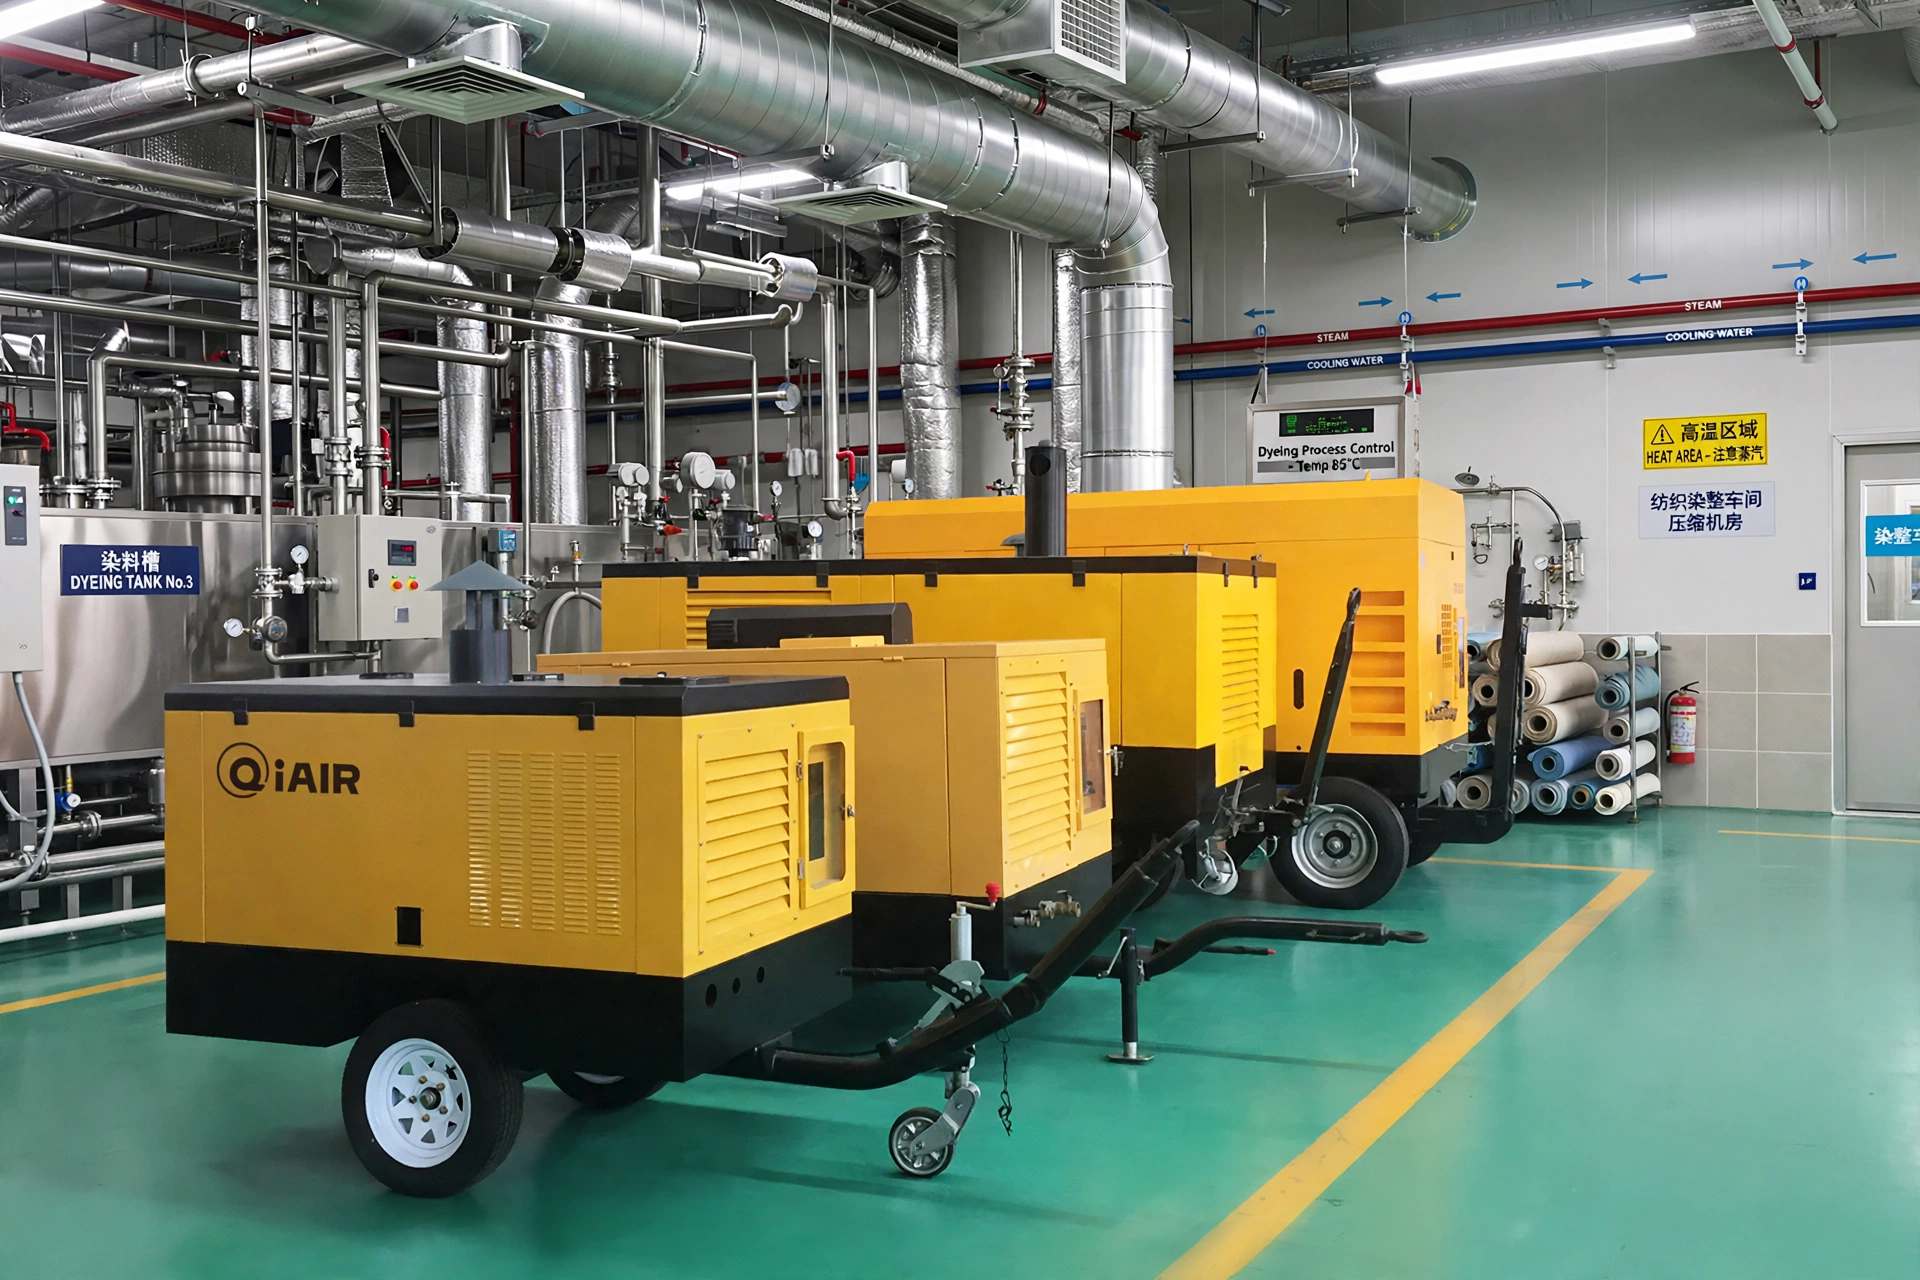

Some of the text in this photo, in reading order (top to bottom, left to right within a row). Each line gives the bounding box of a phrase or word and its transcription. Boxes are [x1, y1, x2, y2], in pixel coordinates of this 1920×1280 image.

[1684, 300, 1722, 311] STEAM
[1316, 331, 1349, 343] STEAM
[1665, 328, 1753, 342] COOLING WATER
[1307, 356, 1384, 370] COOLING WATER
[1681, 419, 1758, 442] 高温区域
[1258, 441, 1395, 459] Dyeing Process Control
[1646, 450, 1673, 464] HEAT
[1675, 448, 1703, 463] AREA
[1296, 459, 1329, 473] Temp
[1650, 490, 1762, 511] 纺织染整车间
[1668, 512, 1743, 532] 压缩机房
[101, 550, 160, 573] 染料槽
[70, 575, 193, 590] DYEING TANK No.3
